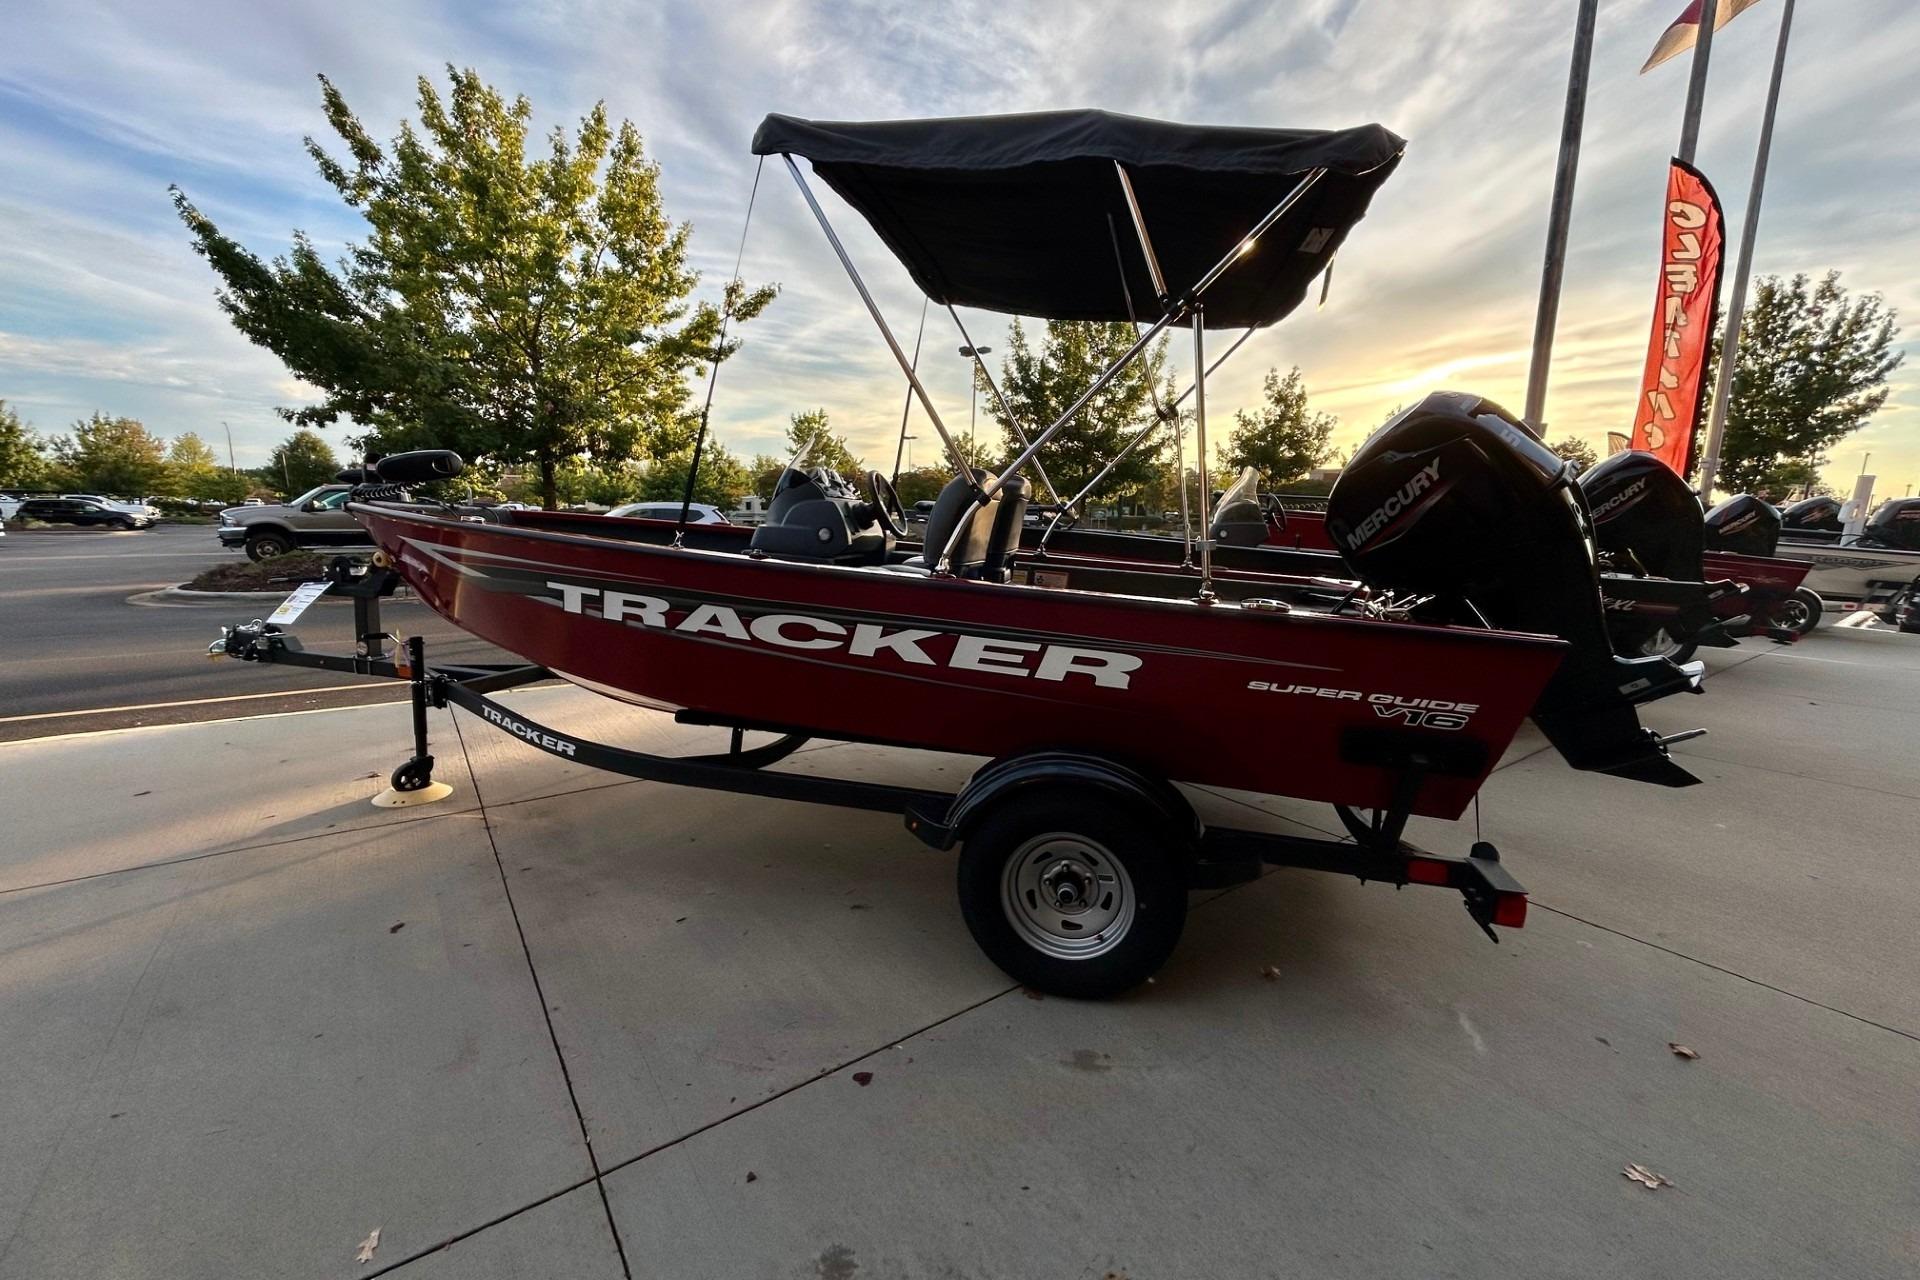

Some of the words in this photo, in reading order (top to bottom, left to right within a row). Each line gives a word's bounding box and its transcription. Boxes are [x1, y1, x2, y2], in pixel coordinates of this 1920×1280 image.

[1346, 456, 1440, 550] MERCURY
[1592, 476, 1647, 519] ERCURY
[546, 581, 1143, 690] TRACKER
[1247, 680, 1362, 700] SUPER
[1367, 694, 1480, 713] GUIDE
[1373, 705, 1469, 730] V16
[482, 705, 576, 756] TRACKER
